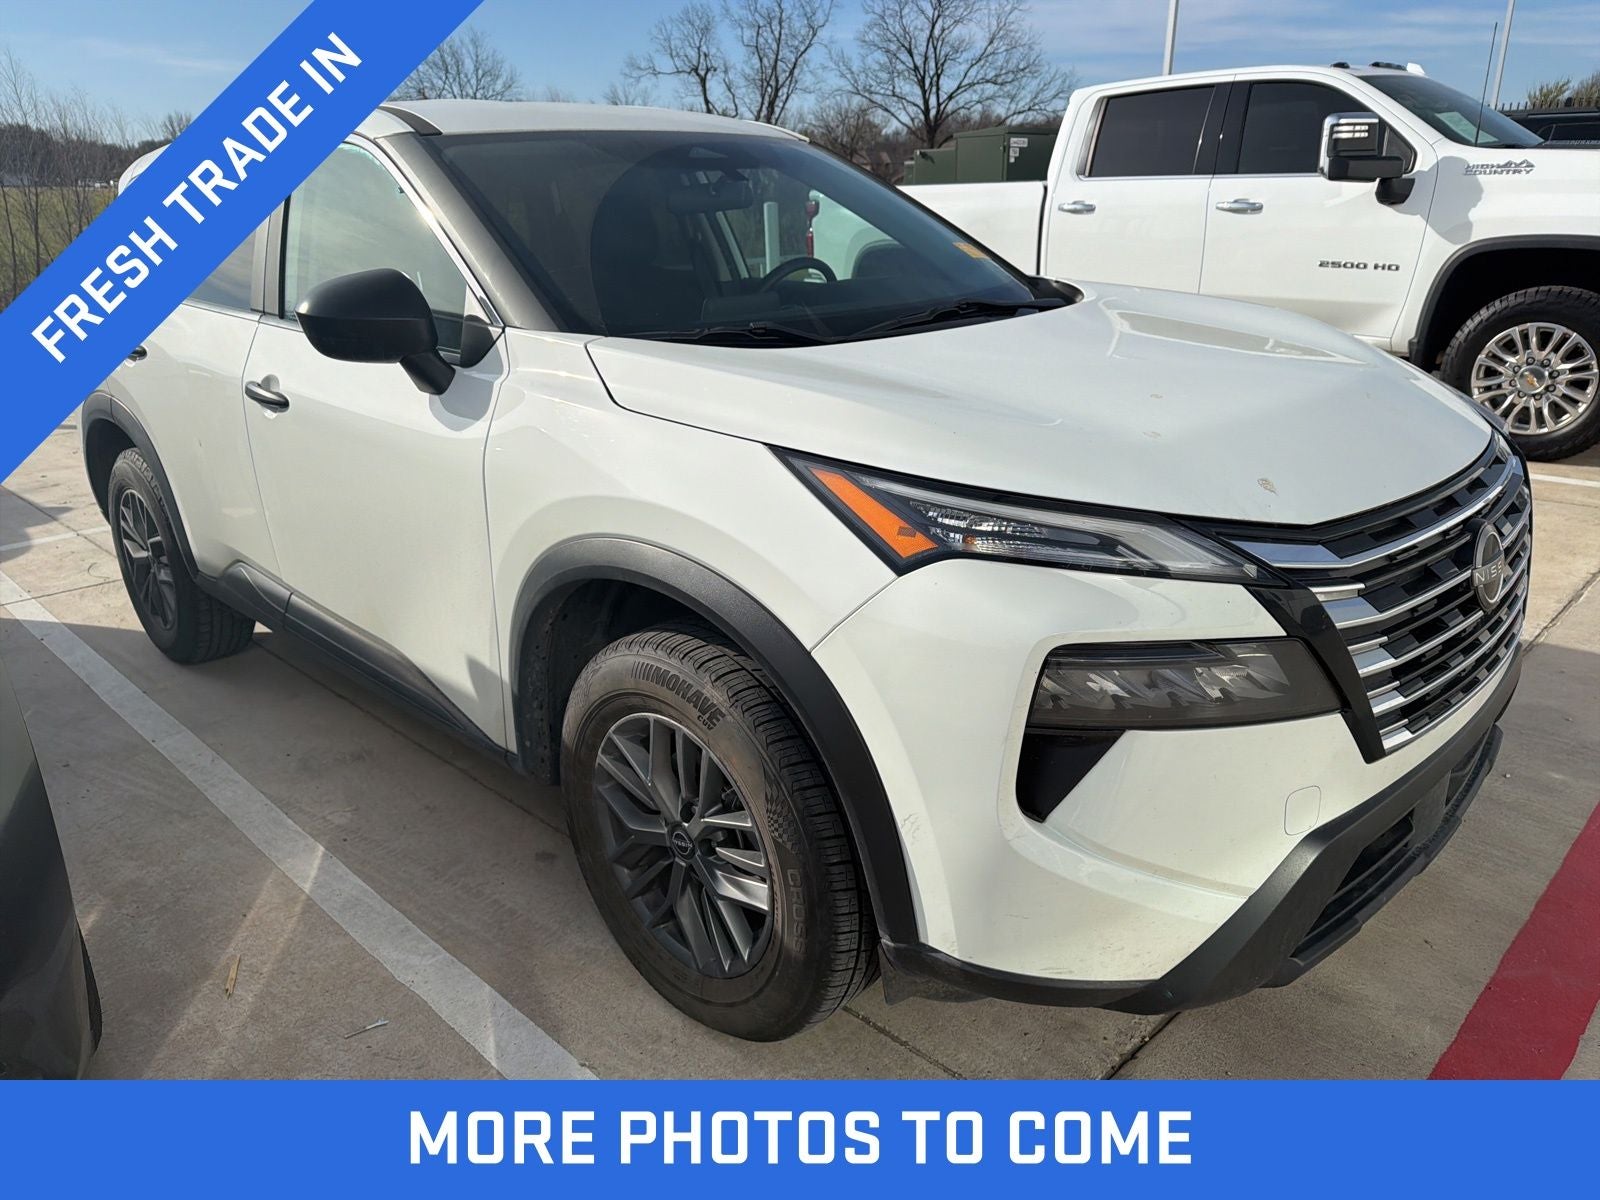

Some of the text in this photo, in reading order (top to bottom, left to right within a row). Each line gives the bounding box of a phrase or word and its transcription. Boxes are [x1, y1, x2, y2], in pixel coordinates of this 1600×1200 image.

[1463, 168, 1534, 176] COUNTRY
[1318, 260, 1400, 272] 2500 HD
[648, 663, 726, 727] MOHAVE
[697, 714, 714, 731] CUV
[786, 868, 808, 954] CROSS
